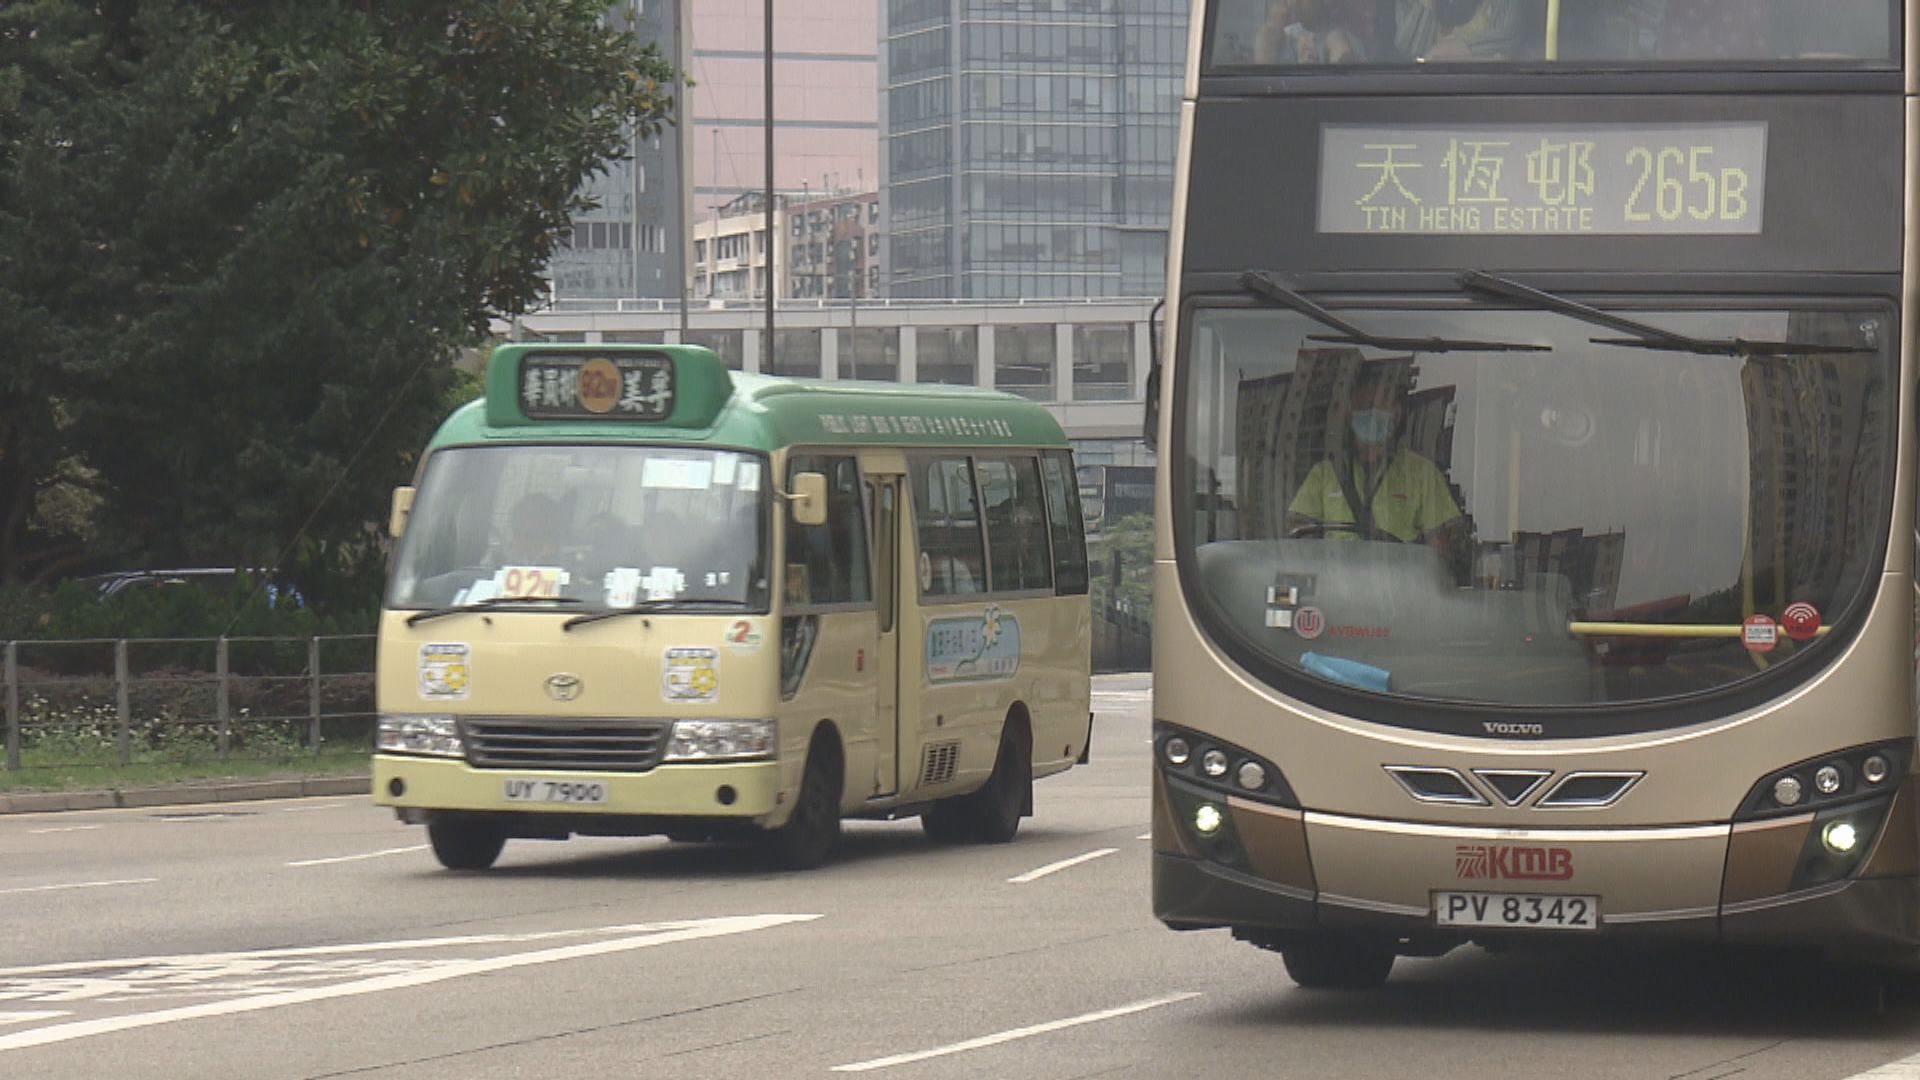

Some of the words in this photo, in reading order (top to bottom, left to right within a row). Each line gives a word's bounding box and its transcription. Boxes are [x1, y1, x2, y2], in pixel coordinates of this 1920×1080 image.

[1624, 145, 1749, 222] 265B
[1361, 206, 1406, 231] TIN
[1419, 206, 1481, 231] HENG
[1494, 206, 1594, 231] ESTATE
[732, 620, 752, 643] 2
[1483, 722, 1544, 734] VOLVO
[505, 780, 537, 799] UY
[543, 781, 604, 802] 7900
[1488, 847, 1574, 881] KMB
[1448, 895, 1489, 922] PV
[1502, 897, 1588, 926] 8342
